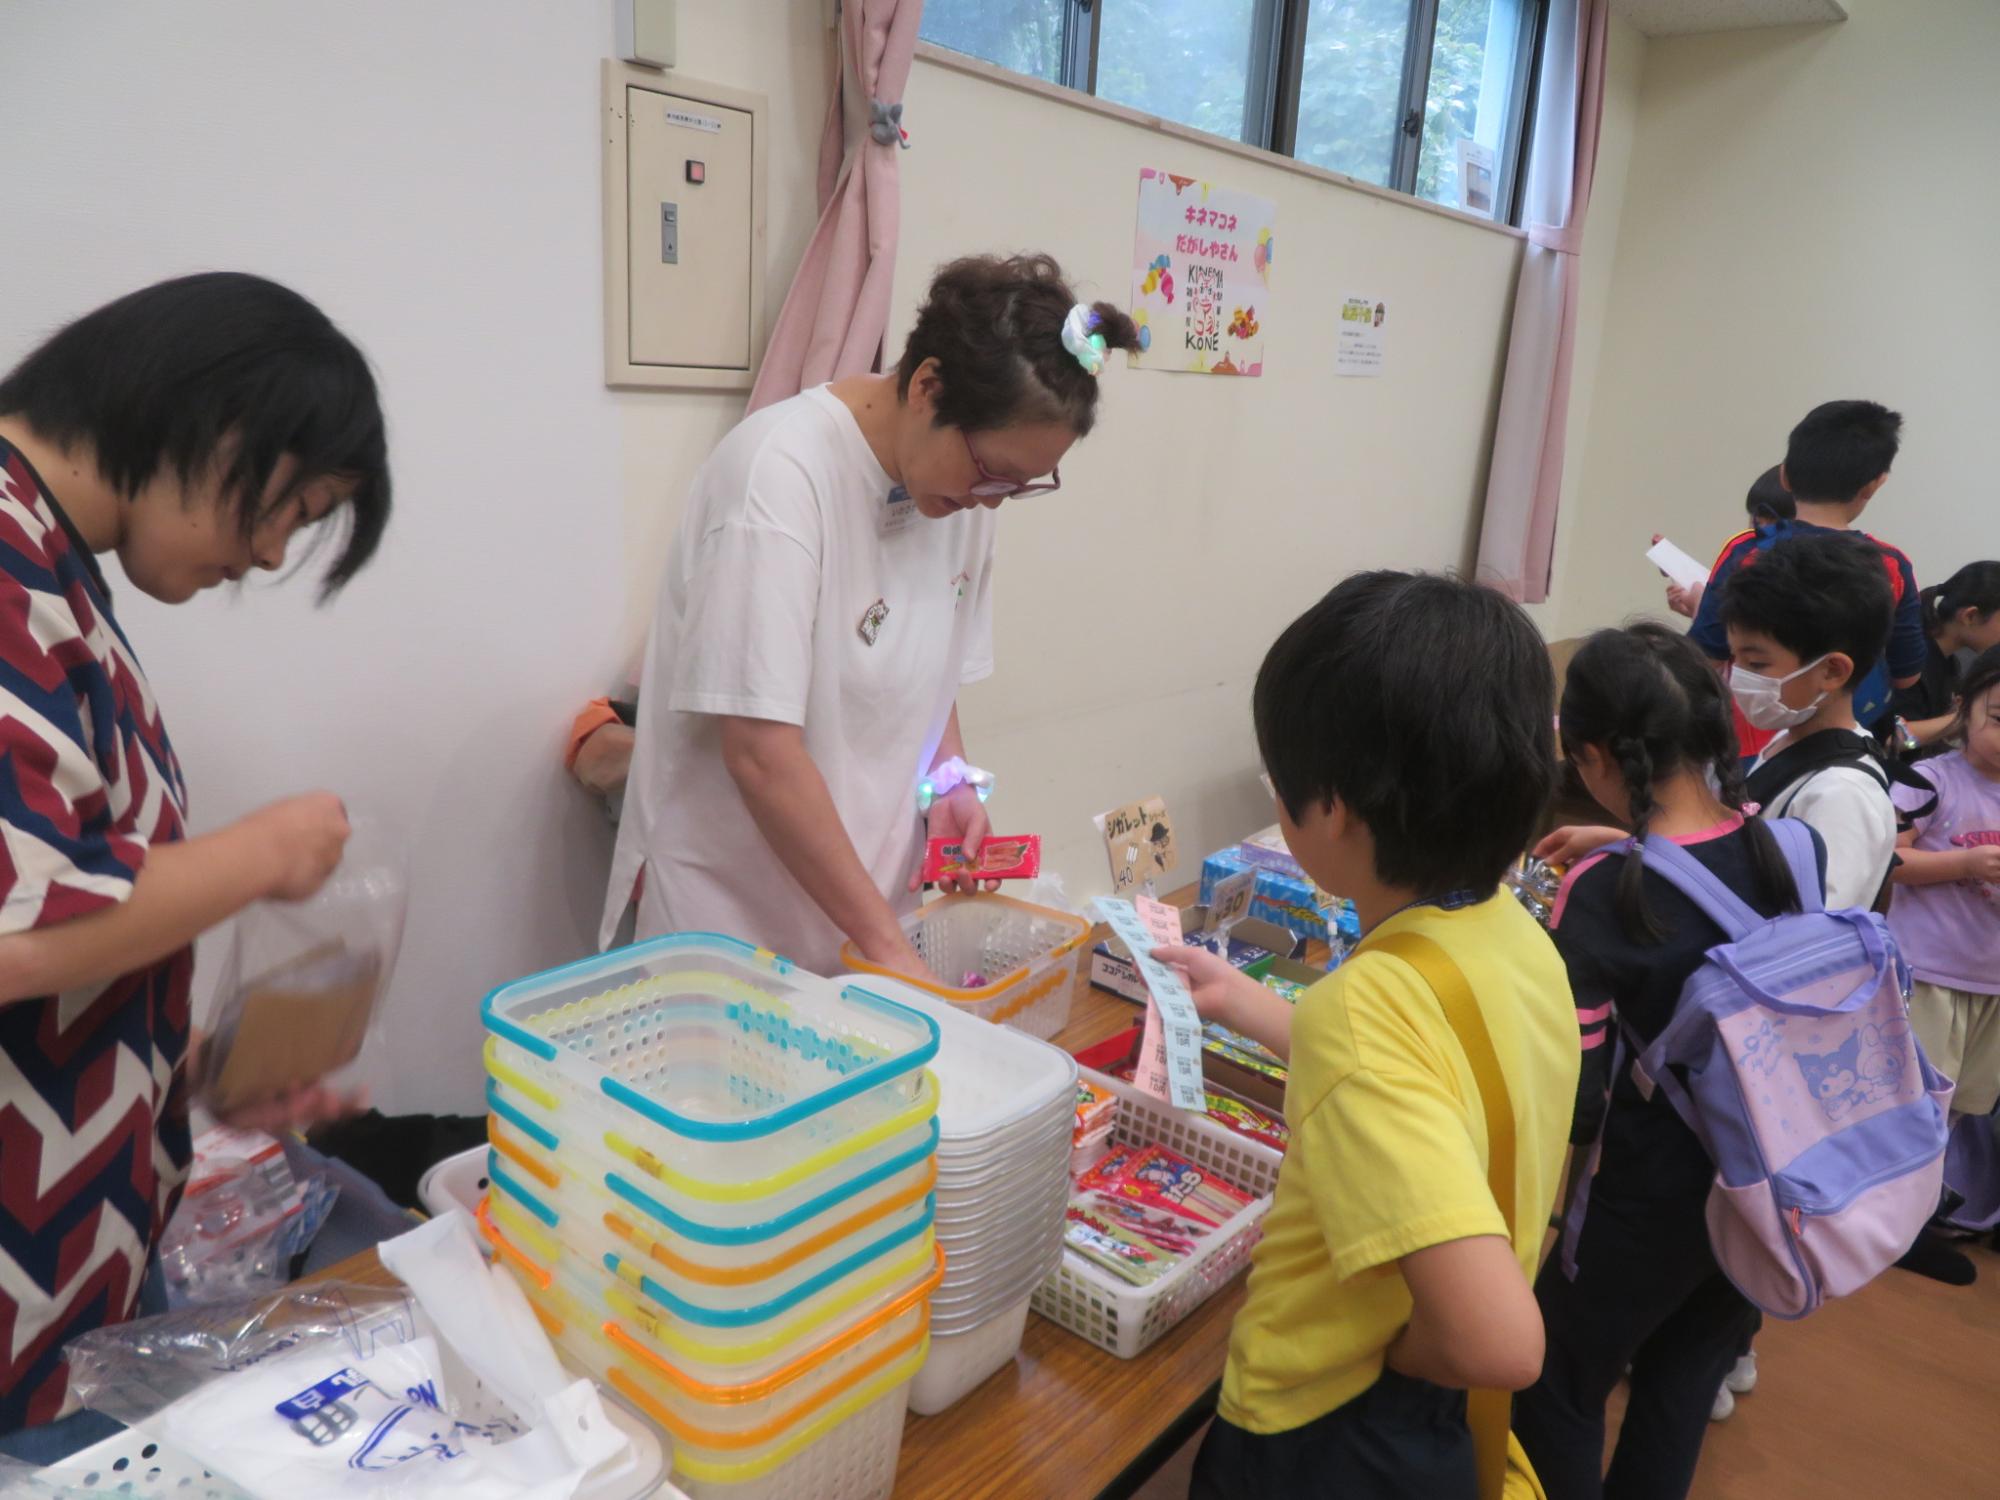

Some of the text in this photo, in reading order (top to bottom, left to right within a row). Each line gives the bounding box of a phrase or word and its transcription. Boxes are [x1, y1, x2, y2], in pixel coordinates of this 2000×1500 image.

[1185, 205, 1238, 232] キネマコネ
[1176, 234, 1239, 263] だがしやさん
[1185, 331, 1219, 351] KONE
[1107, 806, 1147, 840] シガレット
